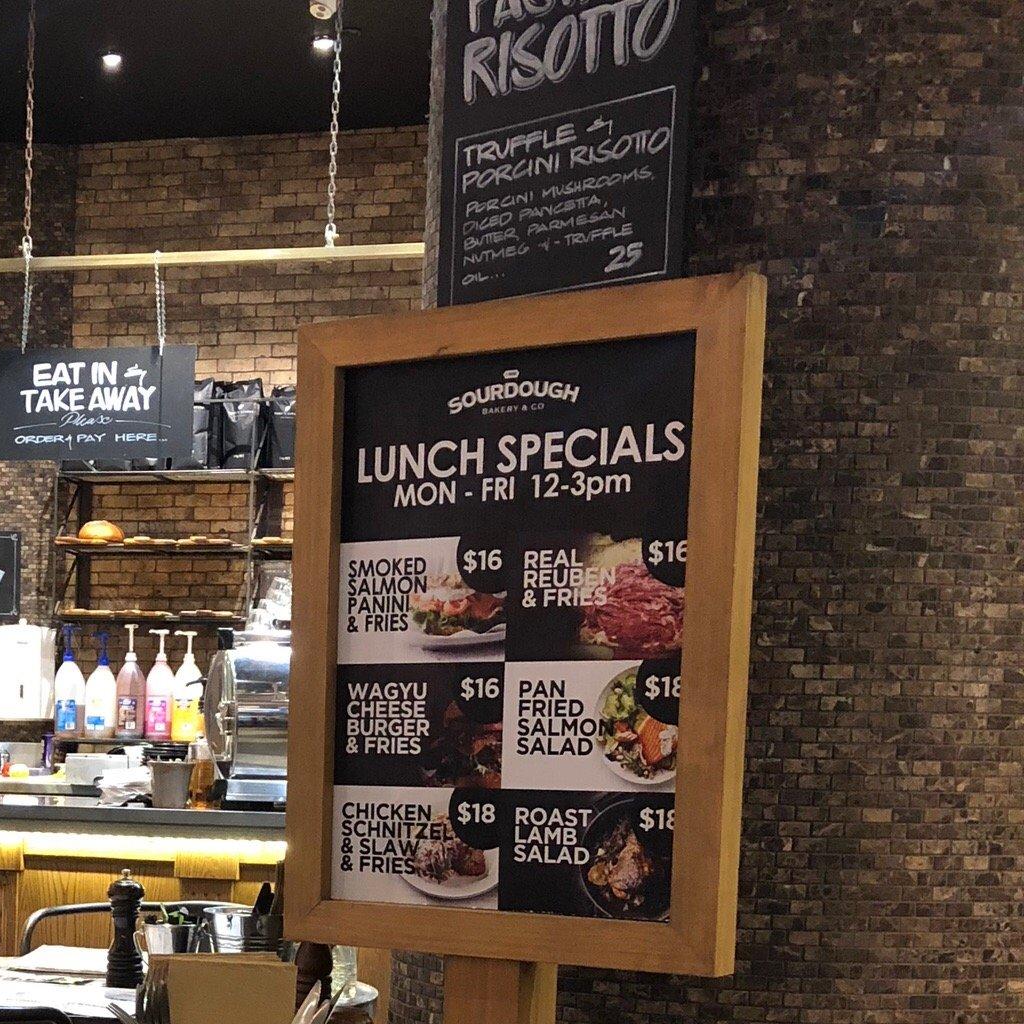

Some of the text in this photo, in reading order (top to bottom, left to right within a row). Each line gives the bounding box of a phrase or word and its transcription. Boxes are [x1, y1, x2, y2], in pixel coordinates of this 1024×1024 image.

[463, 0, 680, 105] RISOTTO
[463, 123, 578, 167] TRUFFLE
[461, 126, 672, 194] PORCINI RISOTTO
[466, 164, 656, 218] PORCINI MUSHROOMS,
[462, 194, 608, 236] DICED PANCETTA,
[527, 206, 627, 237] PARMESAN
[462, 242, 530, 268] NUTMEG
[564, 222, 634, 247] TRUFFLE
[604, 241, 644, 273] 25
[33, 361, 86, 388] EAT
[91, 361, 117, 385] IN
[20, 385, 156, 413] TAKE AWAY
[447, 381, 581, 415] SOURDOUGH
[482, 404, 519, 415] BAKERY
[531, 403, 545, 411] CO
[59, 412, 113, 428] Please
[14, 435, 64, 445] ORDER
[76, 432, 106, 443] PAY
[357, 421, 686, 484] LUNCH SPECIALS
[393, 481, 456, 508] MON
[481, 476, 515, 502] FRI
[532, 471, 631, 502] 12-3pm
[462, 548, 503, 575] $16
[523, 548, 583, 569] REAL
[648, 539, 687, 566] $16
[348, 556, 427, 579] SMOKED
[523, 566, 616, 589] REUBEN
[347, 575, 428, 596] SALMON
[347, 594, 410, 615] PANINI
[522, 587, 608, 608] & FRIES
[347, 612, 409, 634] & FRIES
[347, 682, 428, 700] WAGYU
[460, 677, 499, 700] $16
[519, 680, 565, 699] PAN
[346, 701, 426, 719] CHEESE
[518, 699, 584, 718] FRIED
[346, 719, 429, 737] BURGER
[517, 718, 615, 738] SALMON
[346, 737, 421, 755] & FRIES
[516, 737, 594, 756] SALAD
[342, 802, 432, 822] CHICKEN
[457, 801, 496, 825] $18
[515, 807, 593, 827] ROAST
[341, 820, 456, 842] SCHNITZEL
[514, 826, 578, 845] LAMB
[341, 838, 418, 857] & SLAW
[513, 845, 591, 865] SALAD
[340, 855, 416, 875] & FRIES
